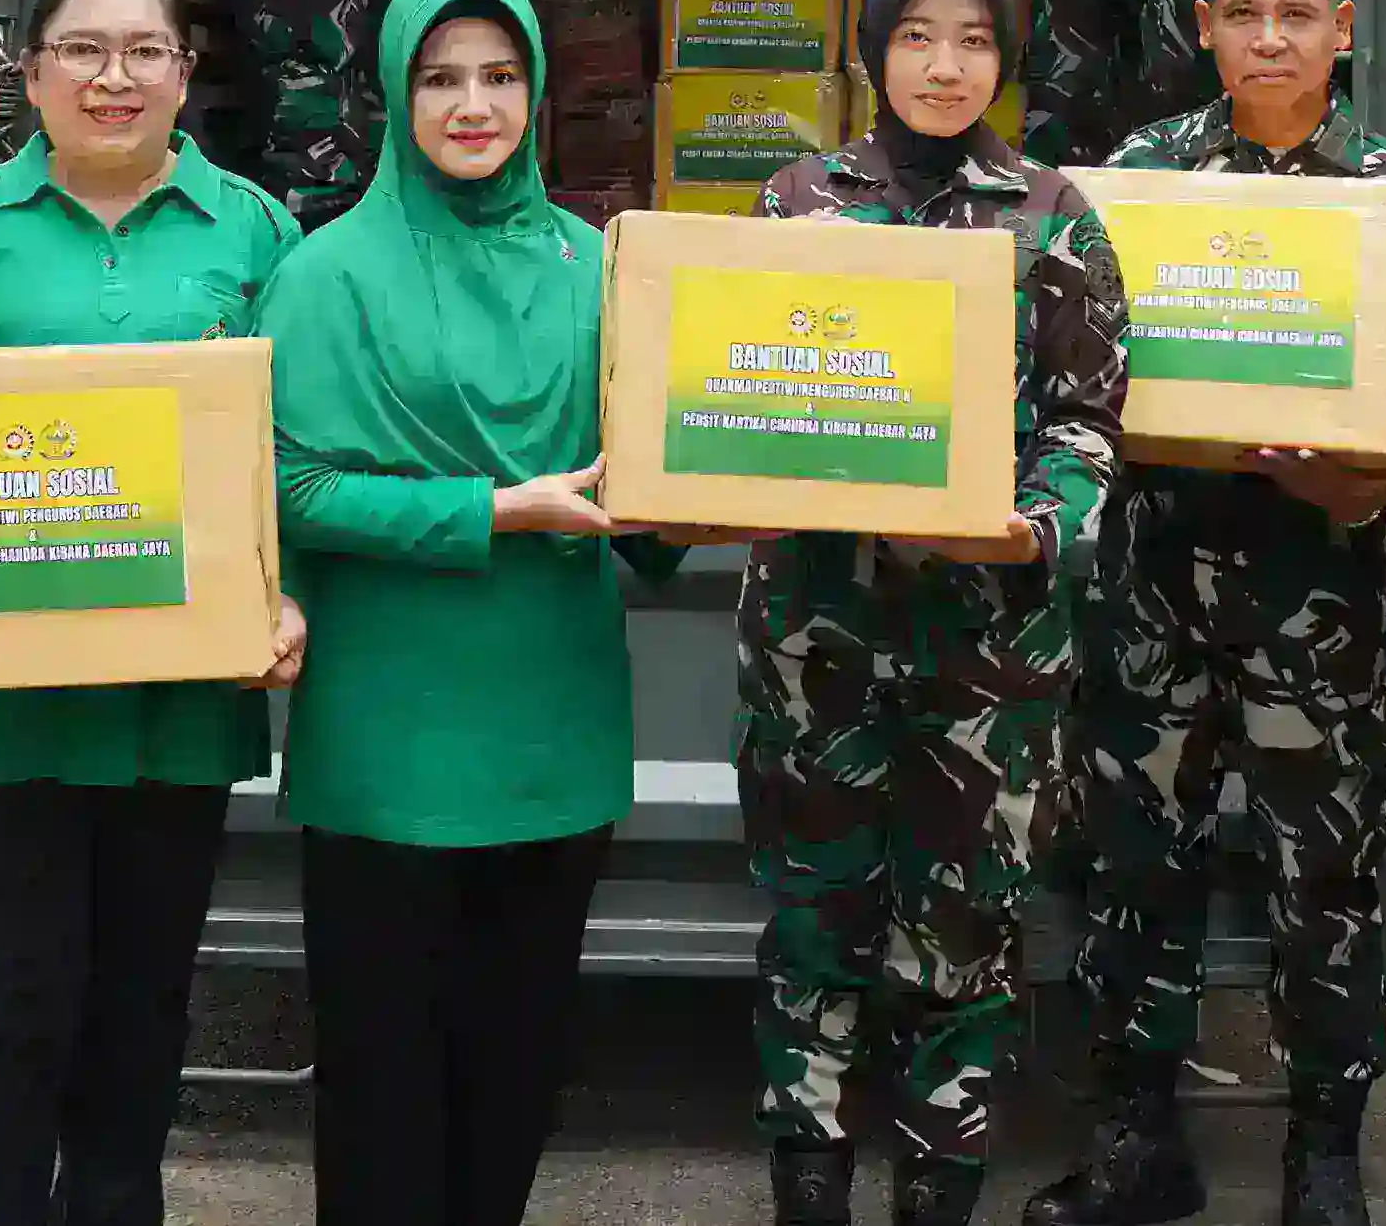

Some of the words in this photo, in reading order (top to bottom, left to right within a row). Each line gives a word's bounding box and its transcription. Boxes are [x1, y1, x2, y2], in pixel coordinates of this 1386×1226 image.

[730, 342, 820, 374] BANTUAN
[826, 350, 894, 378] SOSIAL
[46, 466, 120, 498] SOSIAL
[27, 529, 37, 542] &
[141, 539, 171, 557] JAYA
